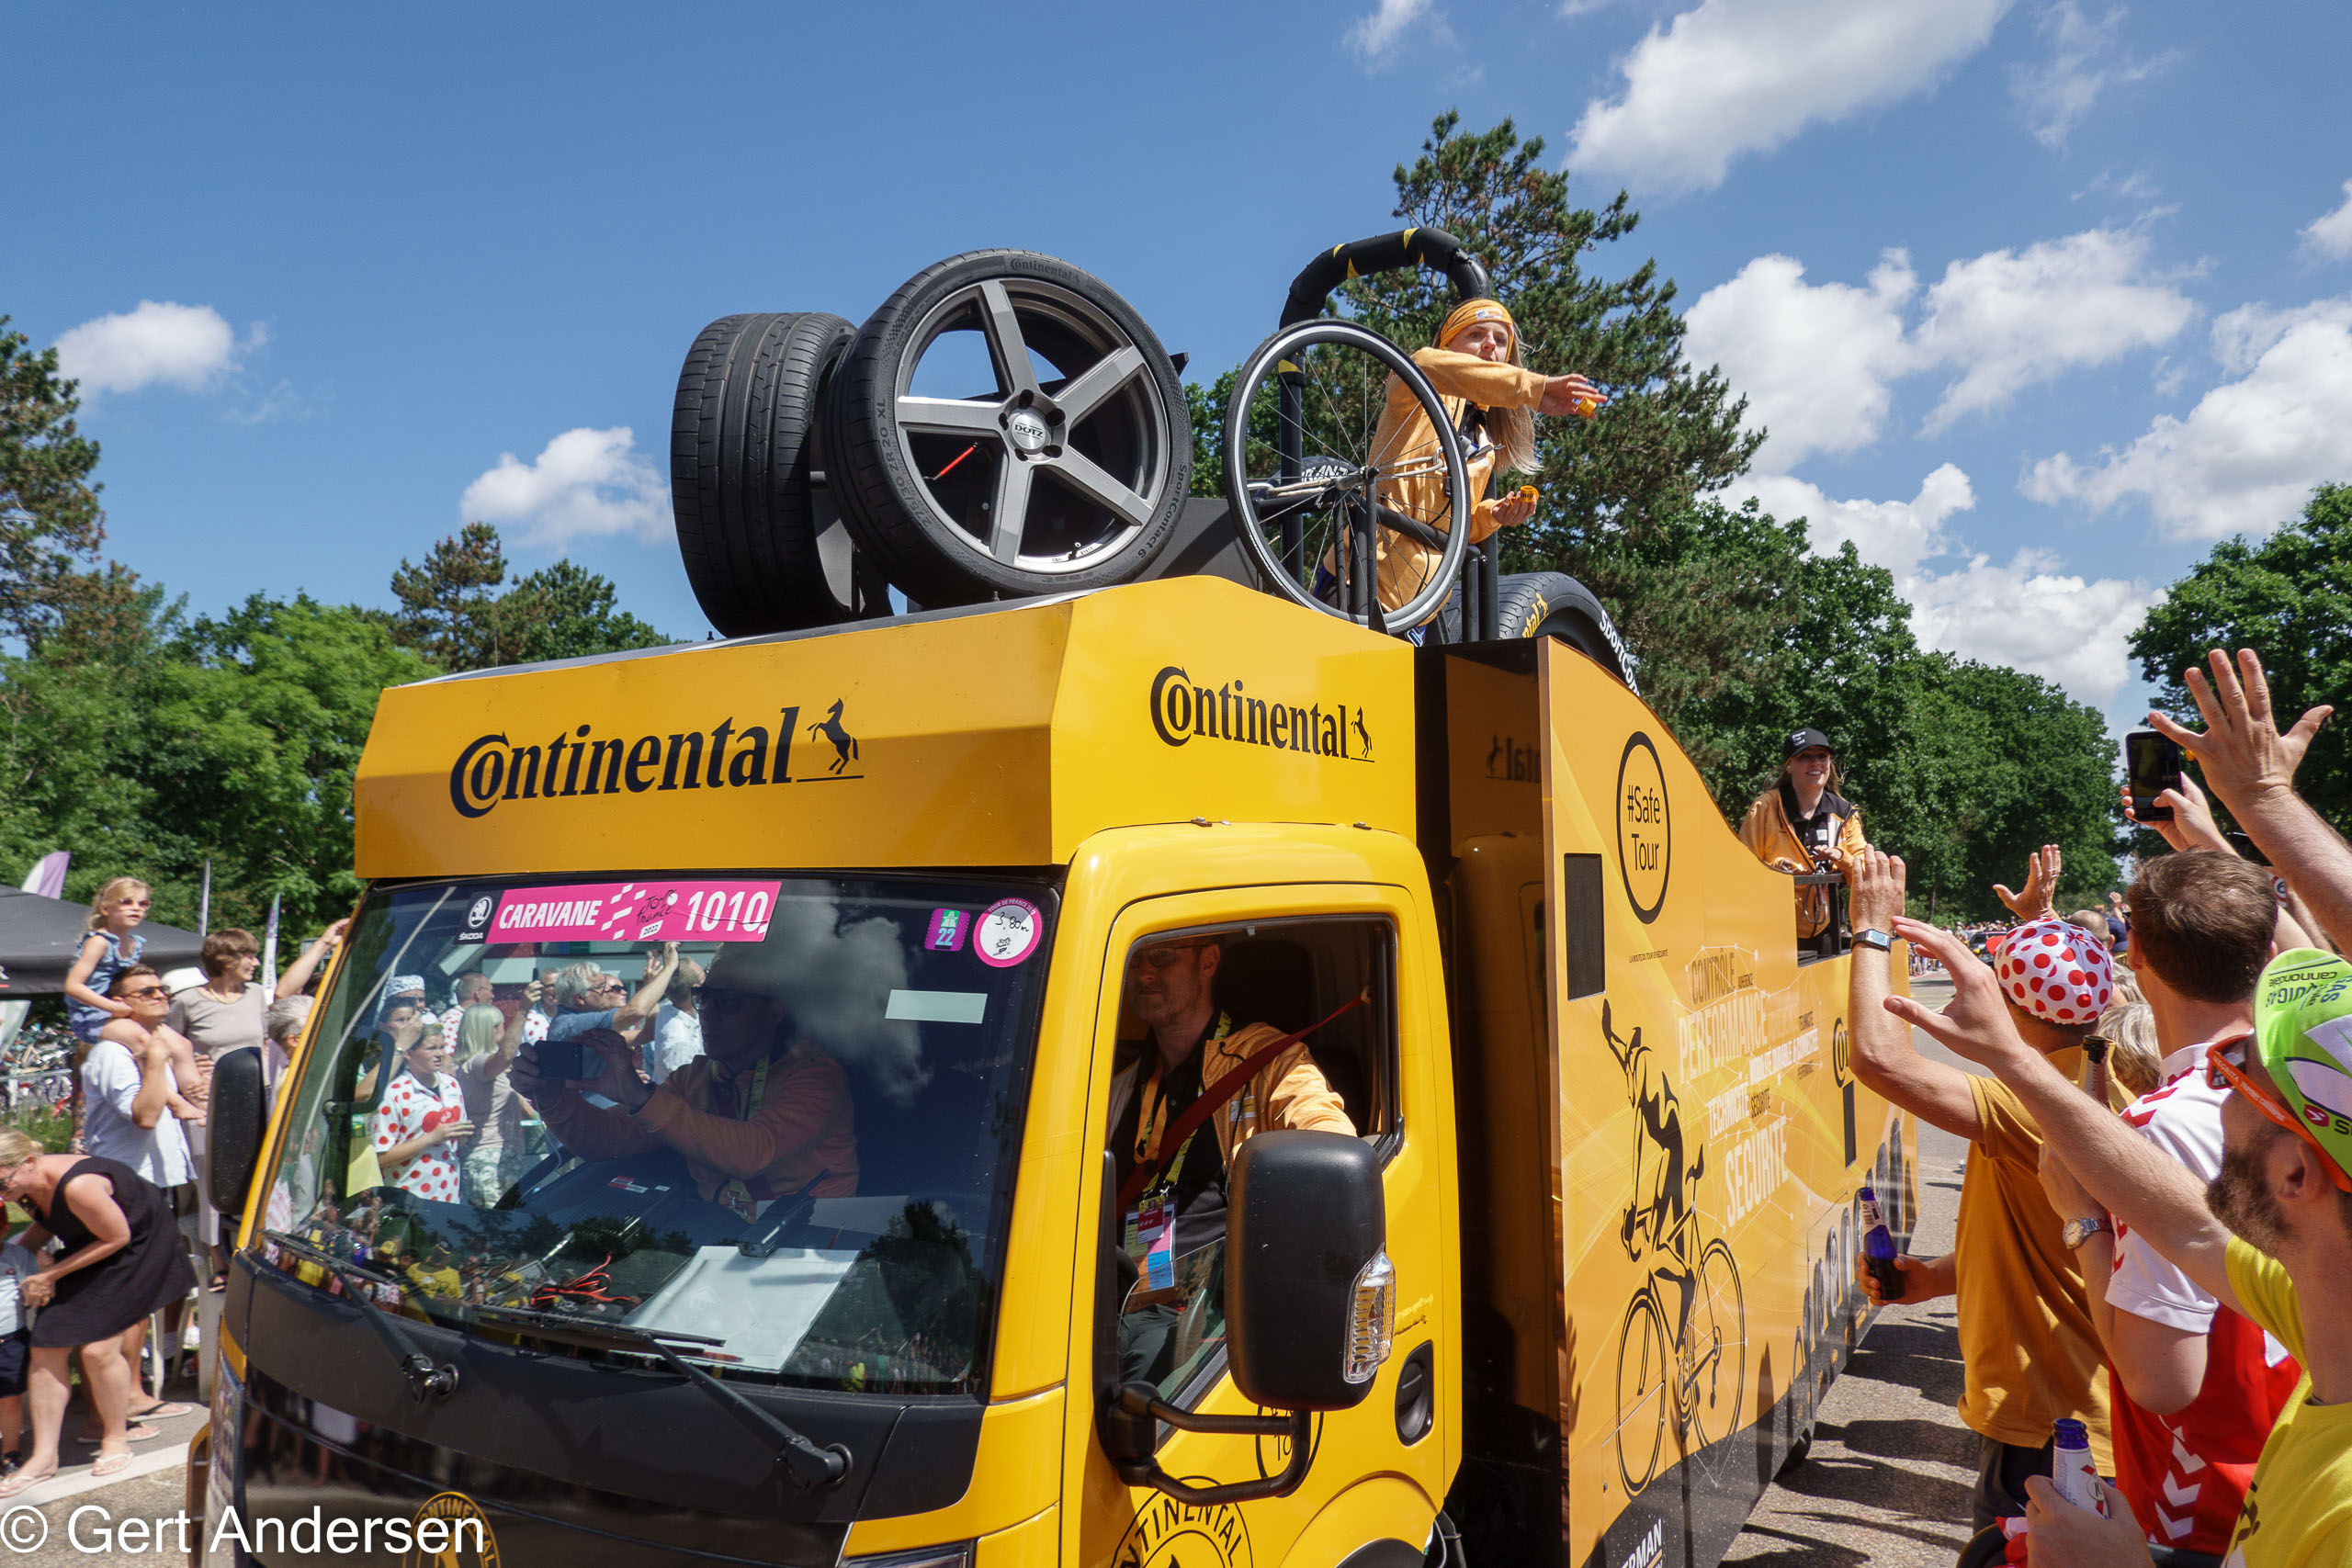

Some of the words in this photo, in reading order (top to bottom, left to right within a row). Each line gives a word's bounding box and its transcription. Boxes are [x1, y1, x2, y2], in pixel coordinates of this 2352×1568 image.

[1012, 258, 1072, 281] Continental
[876, 398, 887, 420] XL
[1014, 424, 1044, 438] DOTZ
[1146, 464, 1188, 549] SportContact
[1600, 610, 1640, 696] SportCon
[1150, 665, 1350, 761] Continental
[449, 705, 800, 818] Continental
[1627, 784, 1660, 824] #Safe
[1631, 833, 1659, 871] Tour
[499, 900, 604, 930] CARAVANE
[685, 890, 769, 931] 1010
[935, 928, 956, 946] 22
[1679, 992, 1768, 1084] PERFORMANCE
